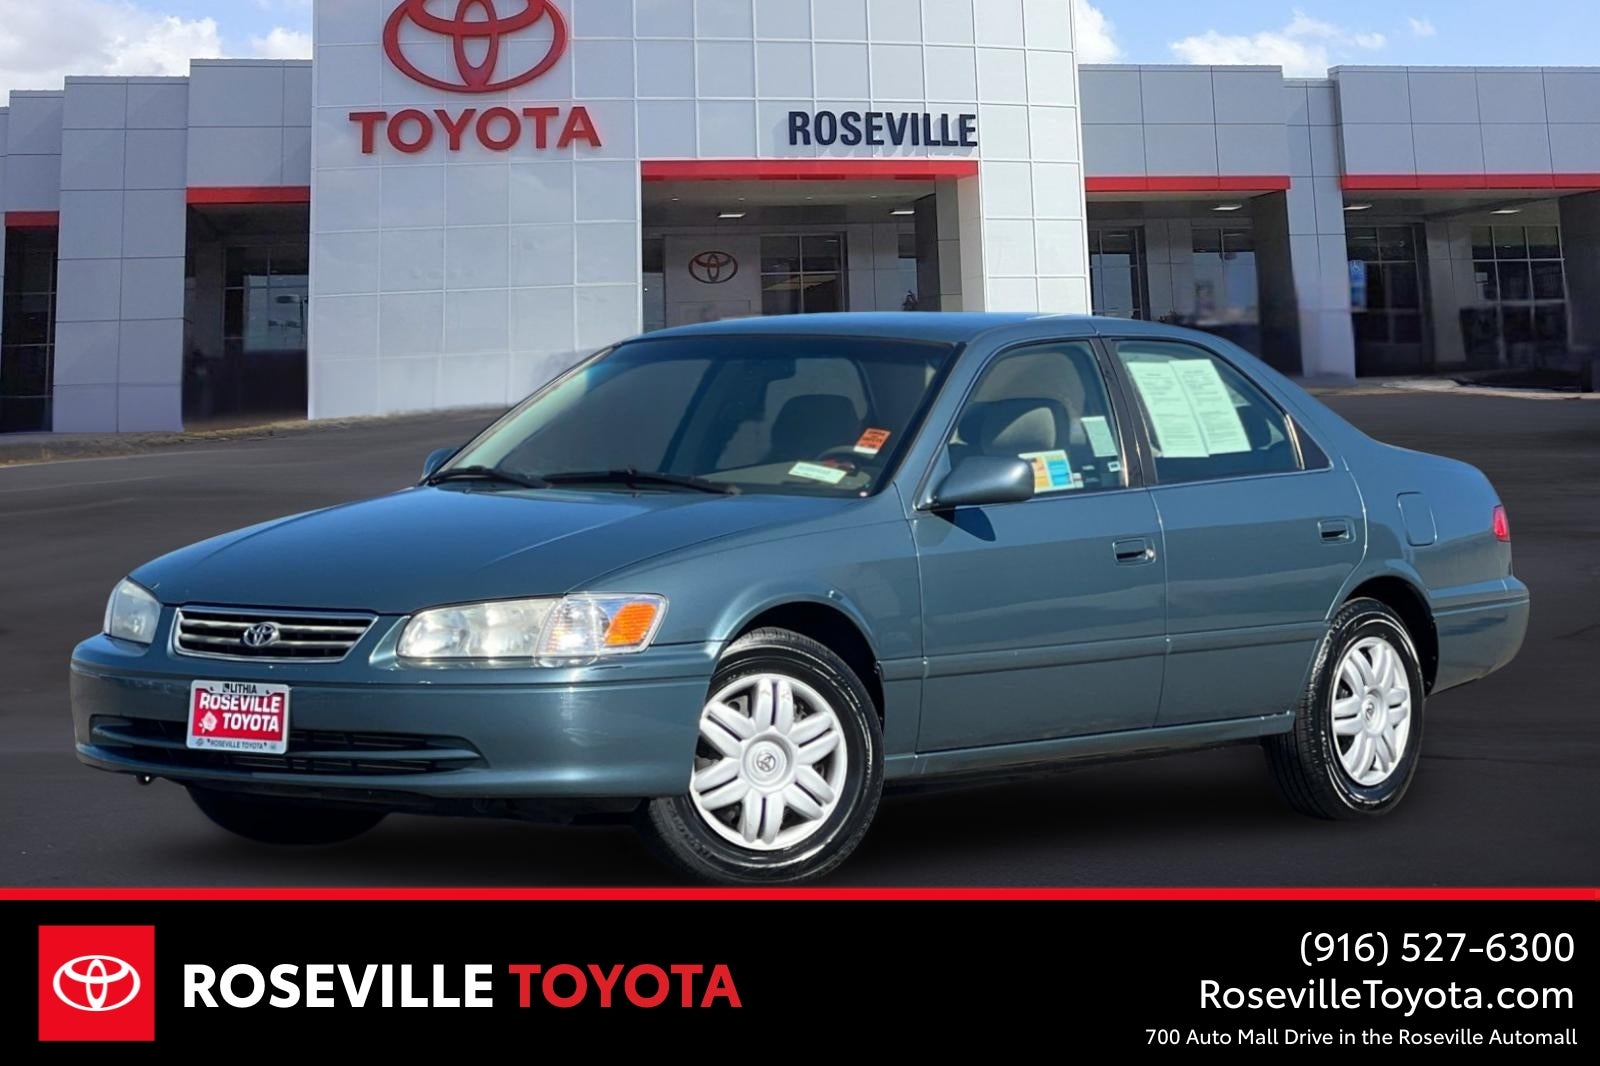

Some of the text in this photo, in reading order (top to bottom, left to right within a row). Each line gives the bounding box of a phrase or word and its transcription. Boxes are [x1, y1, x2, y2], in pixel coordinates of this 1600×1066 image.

[349, 106, 602, 155] TOYOTA
[788, 111, 978, 147] ROSEVILLE
[230, 683, 257, 693] LITHIA
[199, 692, 281, 712] ROSEVILLE
[222, 712, 279, 732] TOYOTA
